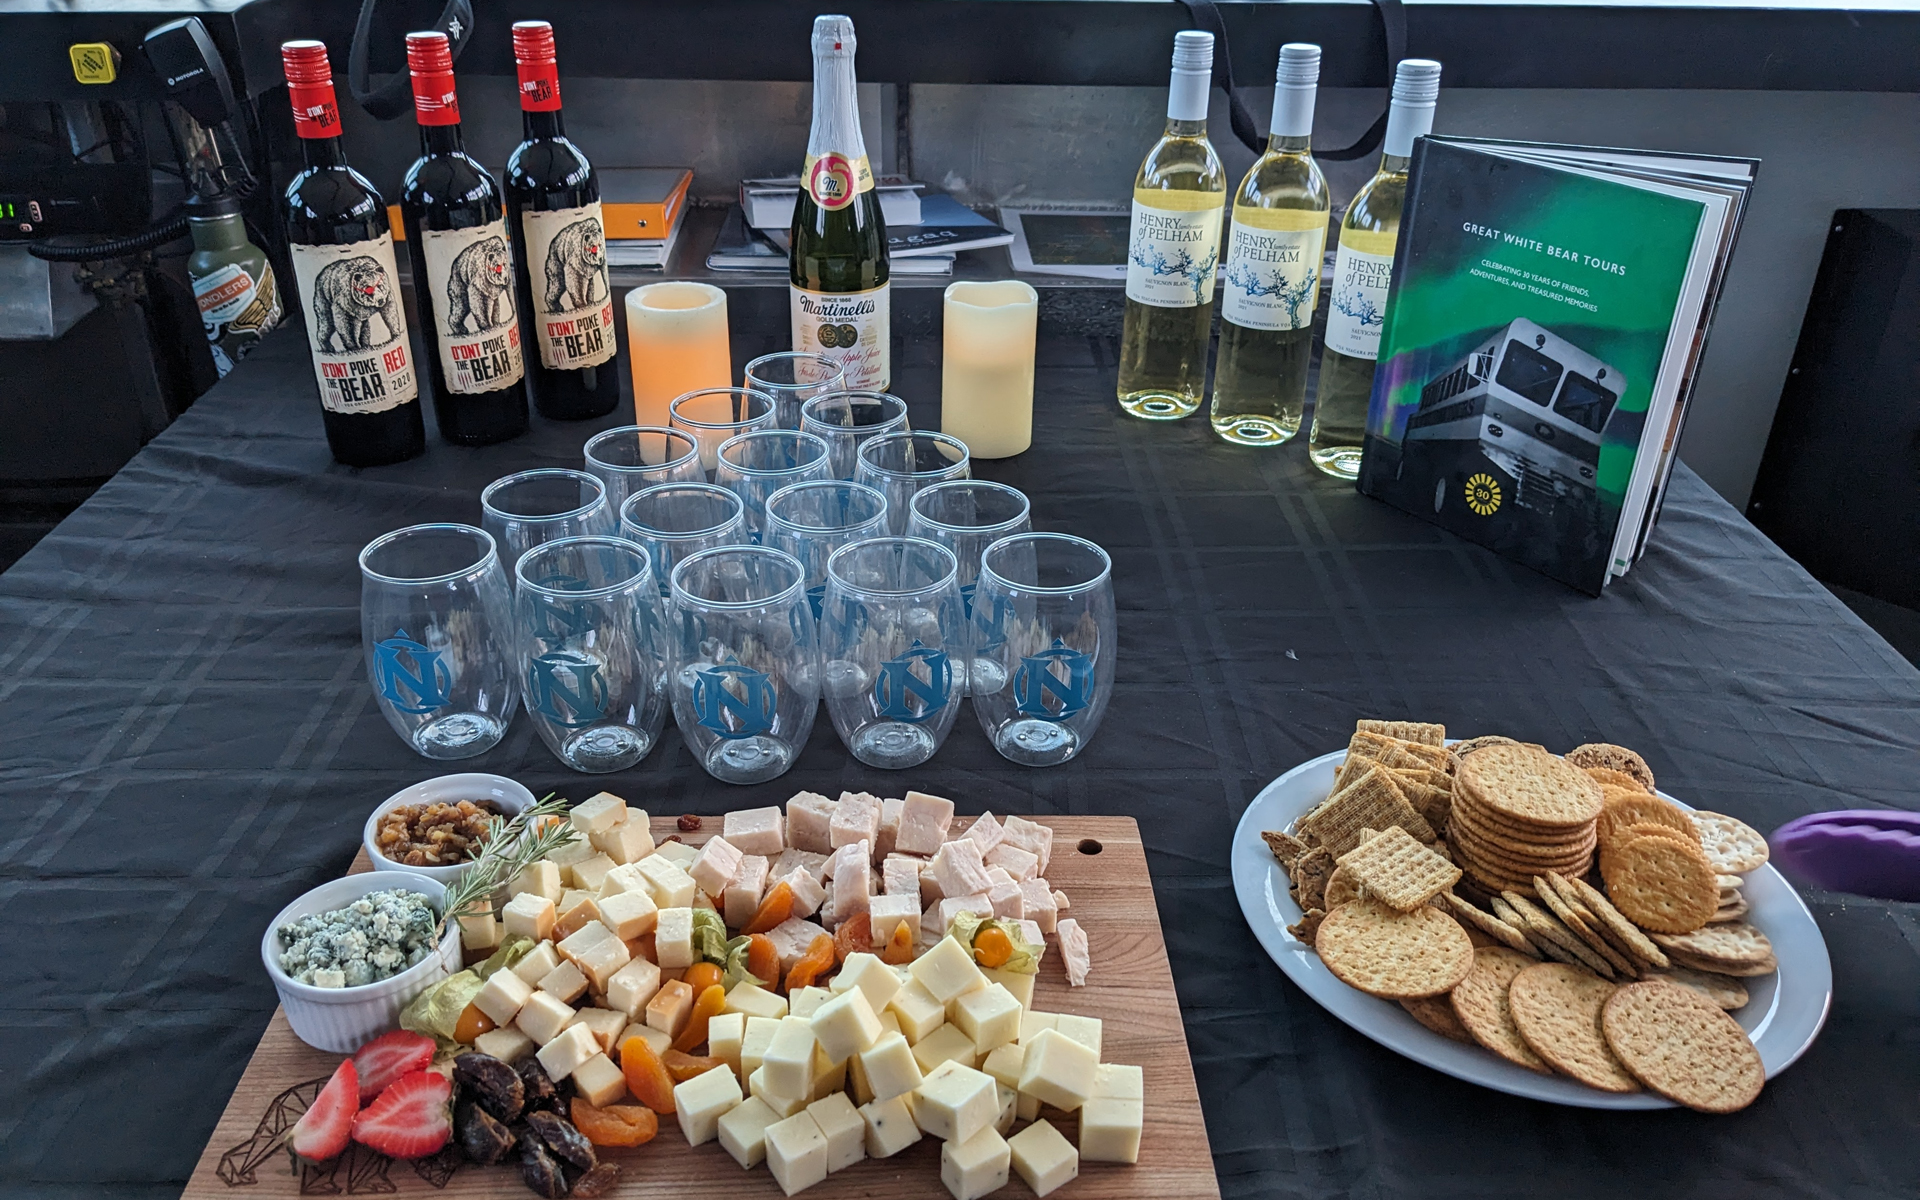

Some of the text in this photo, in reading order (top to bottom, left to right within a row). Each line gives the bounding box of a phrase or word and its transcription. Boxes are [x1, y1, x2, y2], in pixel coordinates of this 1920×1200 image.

[175, 67, 204, 82] MOTOROLA
[530, 86, 553, 103] BEAR
[1140, 212, 1181, 230] HENRY
[1138, 225, 1204, 242] of PELHAM
[1235, 230, 1276, 249] HENRY
[1234, 243, 1300, 263] of PELHAM
[1463, 221, 1626, 276] GREAT WHITE BEAR TOURS
[1348, 257, 1393, 276] HENRY
[1145, 278, 1172, 286] SAUVIGNON
[1345, 272, 1391, 290] of PELH
[1481, 259, 1590, 298] CELEBRATING 30 YEARS OF FRIENDS,
[1141, 295, 1159, 304] NIAGARA
[1469, 268, 1598, 313] ADVENTURES, AND TREASURED MEMORIES
[799, 295, 875, 316] Martinelli's
[1238, 298, 1266, 308] SAUVIGNON
[546, 313, 599, 337] D'ONT POKE
[1234, 316, 1252, 325] NIAGARA
[450, 335, 506, 360] D'ONT POKE
[550, 327, 604, 359] THE BEAR
[1345, 347, 1366, 355] NIAGARA
[383, 345, 406, 374] RED
[455, 349, 511, 382] THE BEAR
[578, 353, 597, 362] ONTARIO
[837, 349, 862, 366] Apple
[861, 345, 881, 364] Juice
[321, 358, 379, 378] D'ONT POKE
[325, 372, 387, 403] THE BEAR
[391, 372, 411, 391] 2020
[485, 376, 504, 385] ONTARIO
[354, 399, 376, 407] ONTARIO
[1476, 488, 1490, 500] 30
[373, 640, 453, 706] N
[1015, 653, 1092, 712] N
[531, 656, 606, 720] N
[879, 651, 949, 716] N
[695, 670, 774, 730] N
